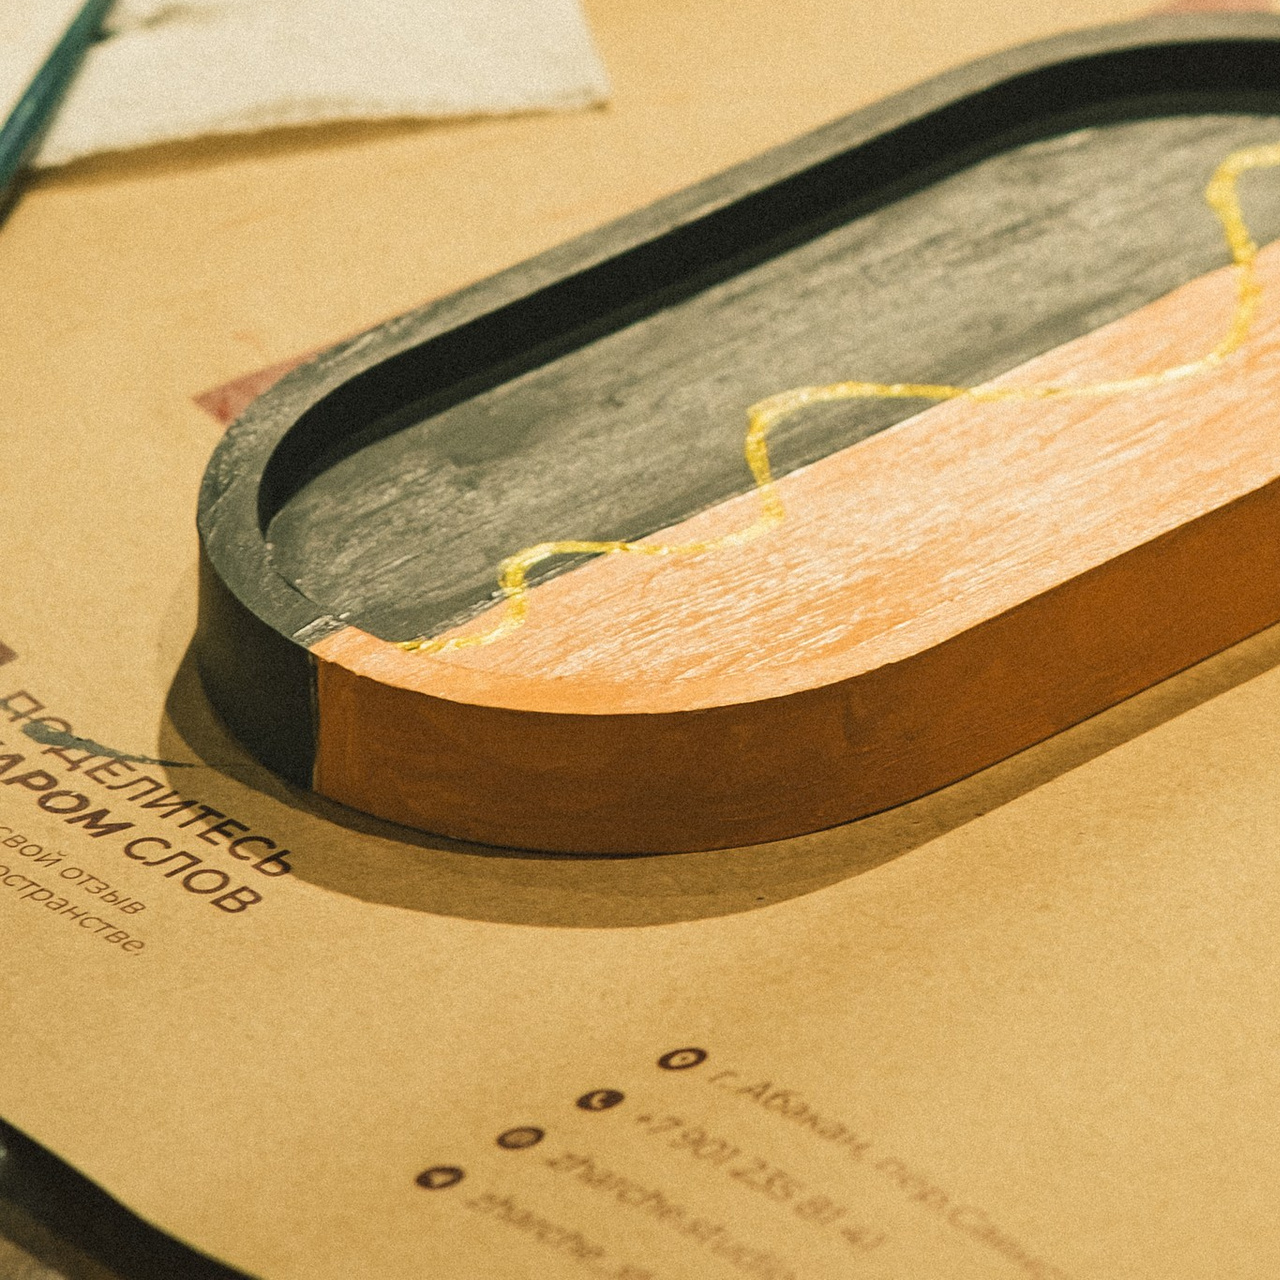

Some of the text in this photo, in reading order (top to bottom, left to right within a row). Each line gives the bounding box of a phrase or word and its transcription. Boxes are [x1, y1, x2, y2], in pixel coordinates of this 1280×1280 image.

[0, 740, 262, 914] АРОМ СЛОВ
[60, 867, 146, 916] отзыв
